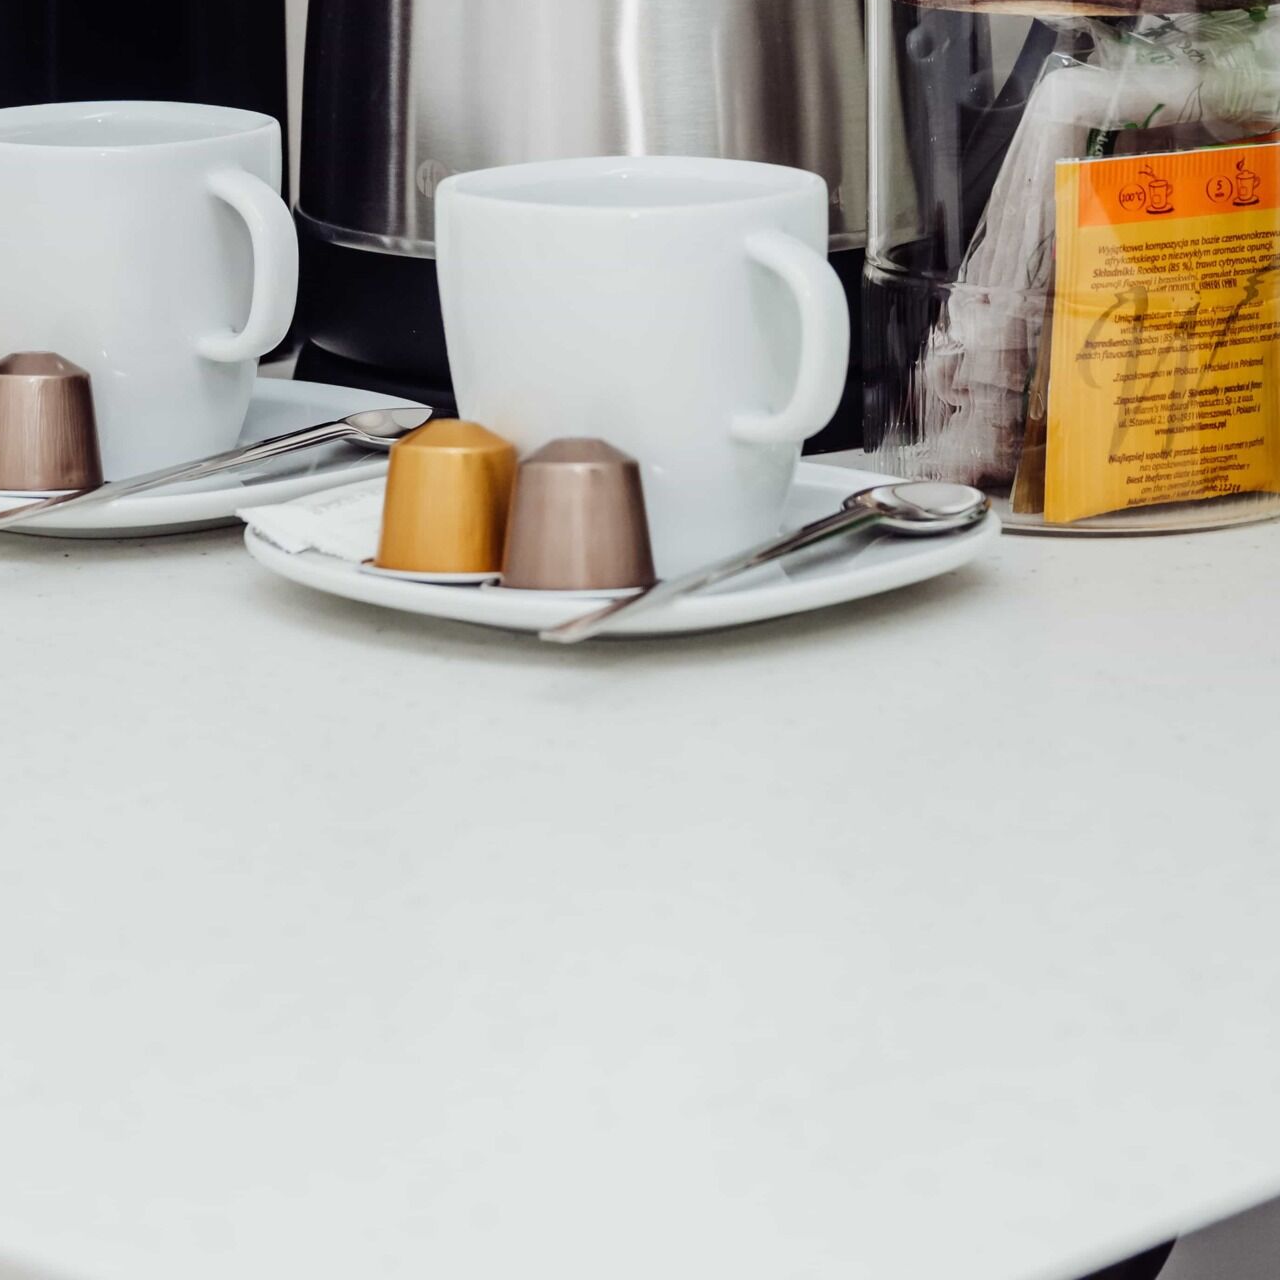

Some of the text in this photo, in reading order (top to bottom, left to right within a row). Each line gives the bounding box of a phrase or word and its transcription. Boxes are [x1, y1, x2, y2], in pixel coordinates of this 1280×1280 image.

[1190, 238, 1200, 246] na
[1201, 236, 1220, 244] bazie
[1212, 245, 1246, 255] aromacie
[1196, 260, 1216, 269] trawa
